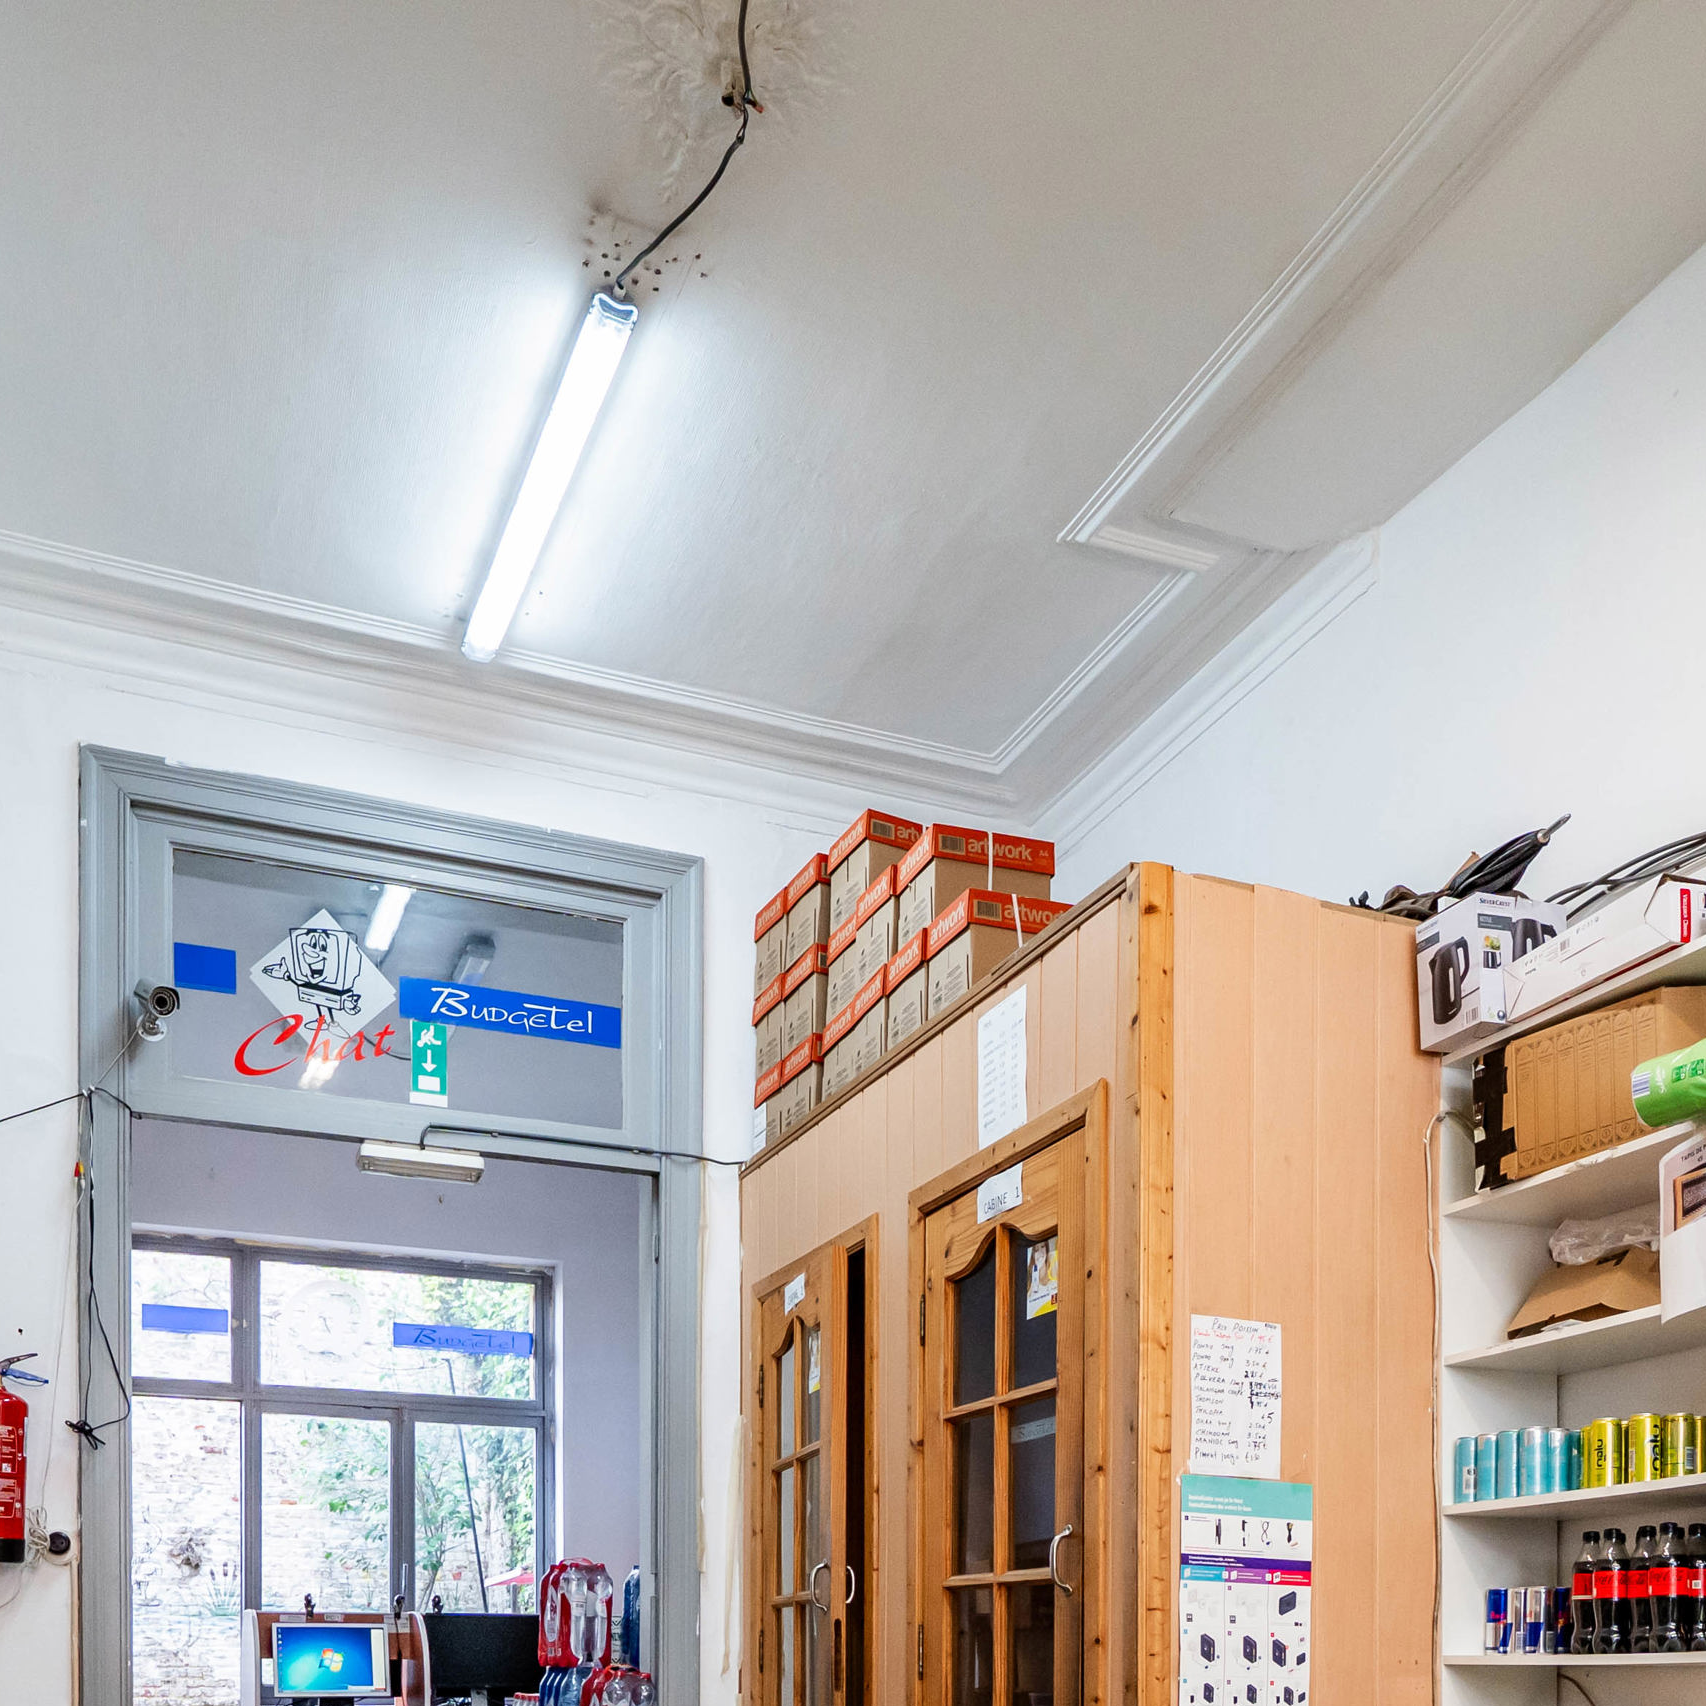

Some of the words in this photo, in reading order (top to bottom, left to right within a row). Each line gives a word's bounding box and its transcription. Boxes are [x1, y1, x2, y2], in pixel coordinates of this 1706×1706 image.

[931, 902, 966, 938] artwork
[234, 1014, 396, 1076] Chat
[984, 1191, 1007, 1214] CABINE
[1596, 1439, 1606, 1468] nalu
